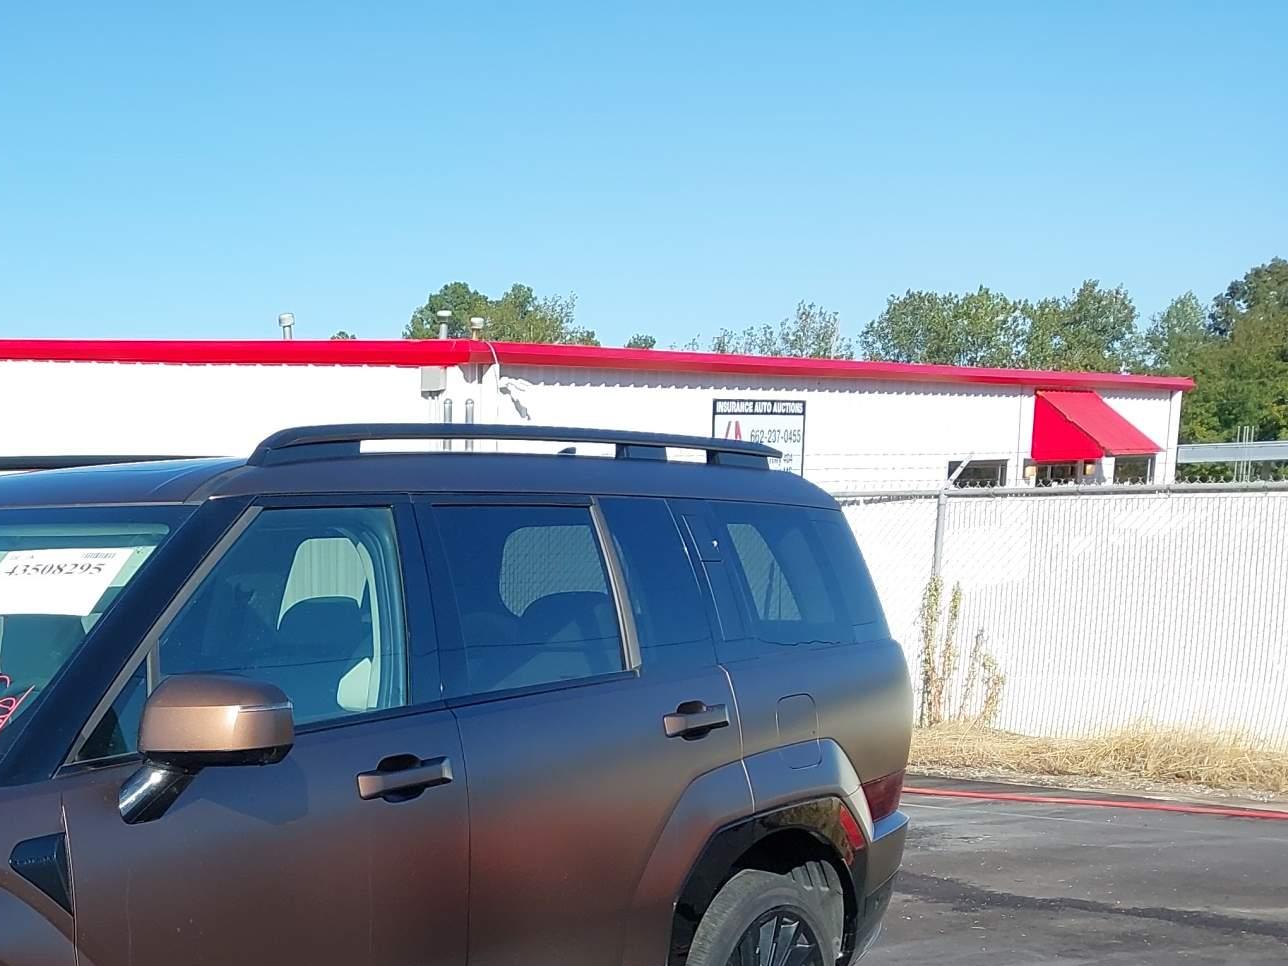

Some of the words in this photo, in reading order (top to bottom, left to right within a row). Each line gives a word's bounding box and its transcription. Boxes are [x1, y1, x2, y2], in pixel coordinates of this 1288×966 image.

[715, 400, 754, 413] INSURANCE
[754, 401, 772, 413] AUTO
[773, 401, 804, 414] AUCTIONS
[750, 428, 801, 444] 662-237-0455
[4, 563, 106, 577] 43508295
